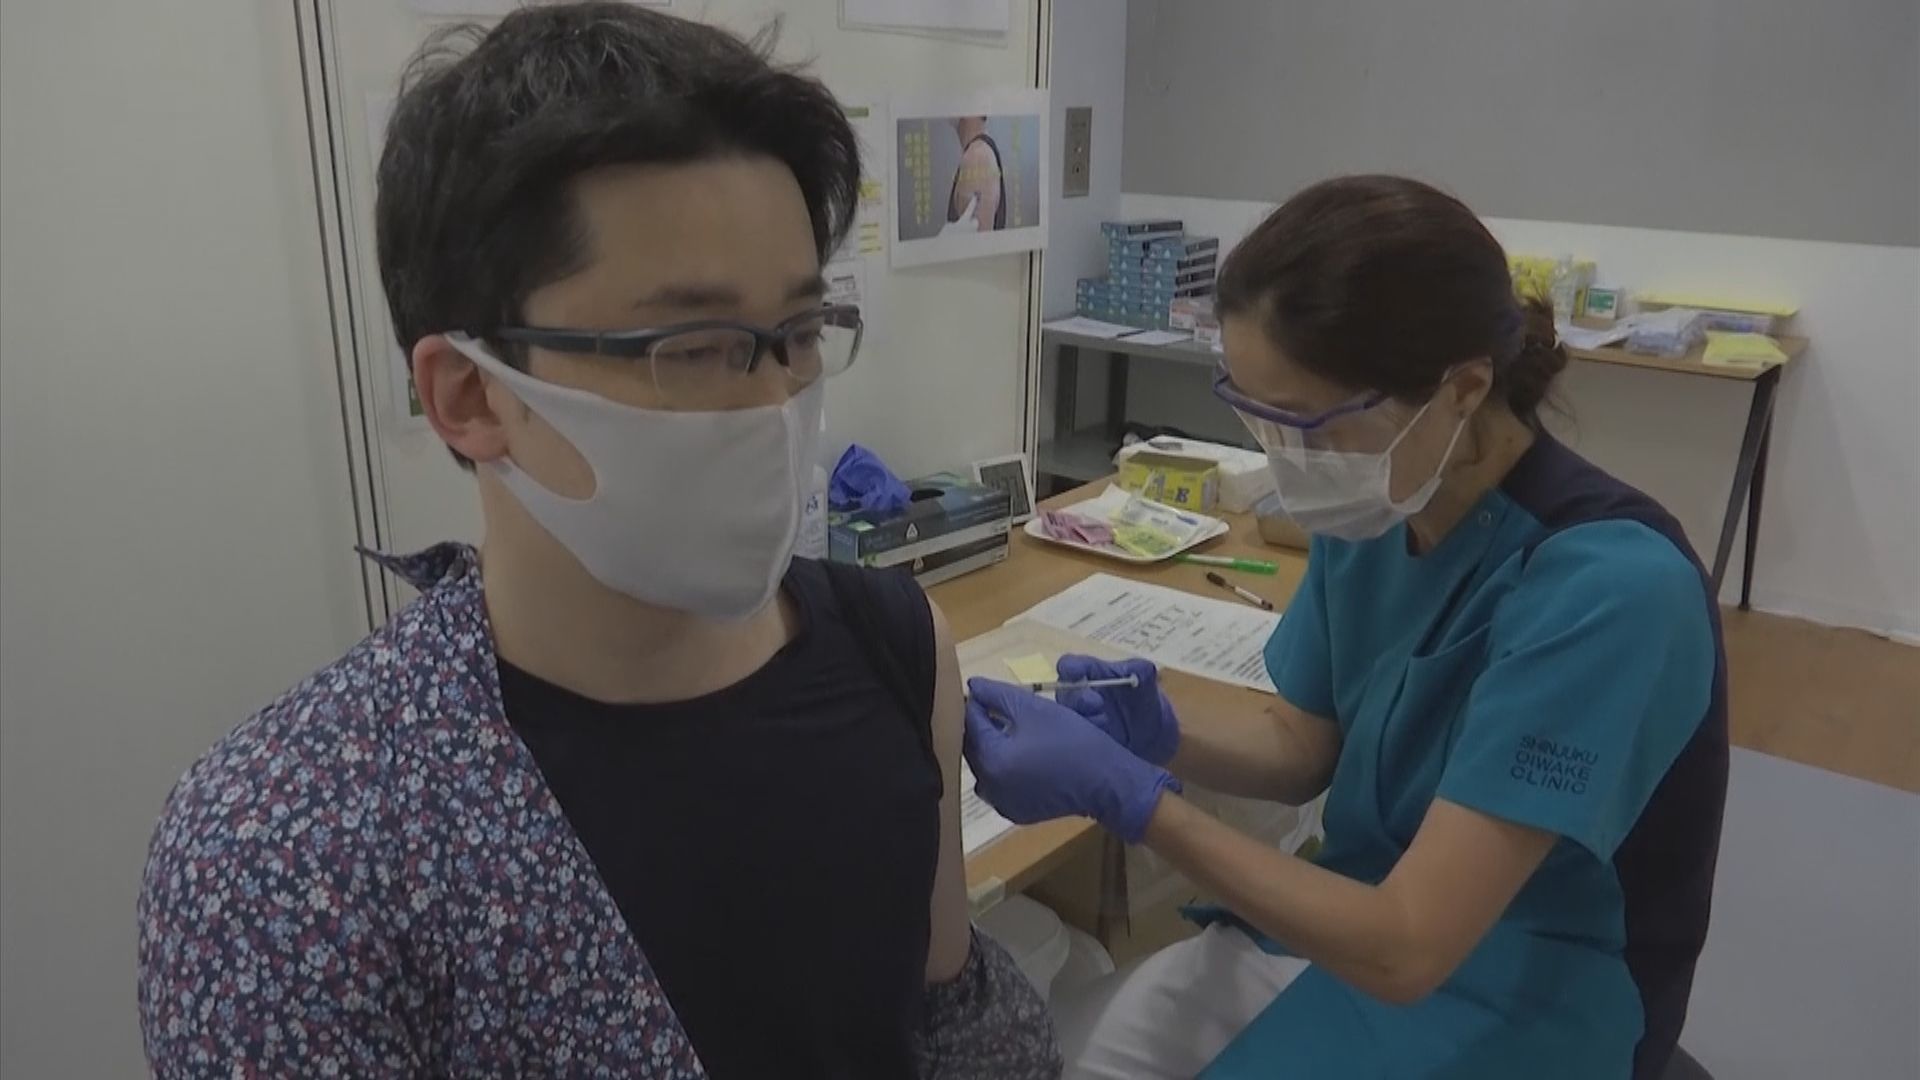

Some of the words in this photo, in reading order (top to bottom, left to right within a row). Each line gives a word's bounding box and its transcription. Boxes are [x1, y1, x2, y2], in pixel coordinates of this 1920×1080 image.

[1519, 735, 1599, 765] SHINJUKU
[1510, 765, 1587, 795] CLINIC
[1515, 750, 1593, 782] OIWAKE
